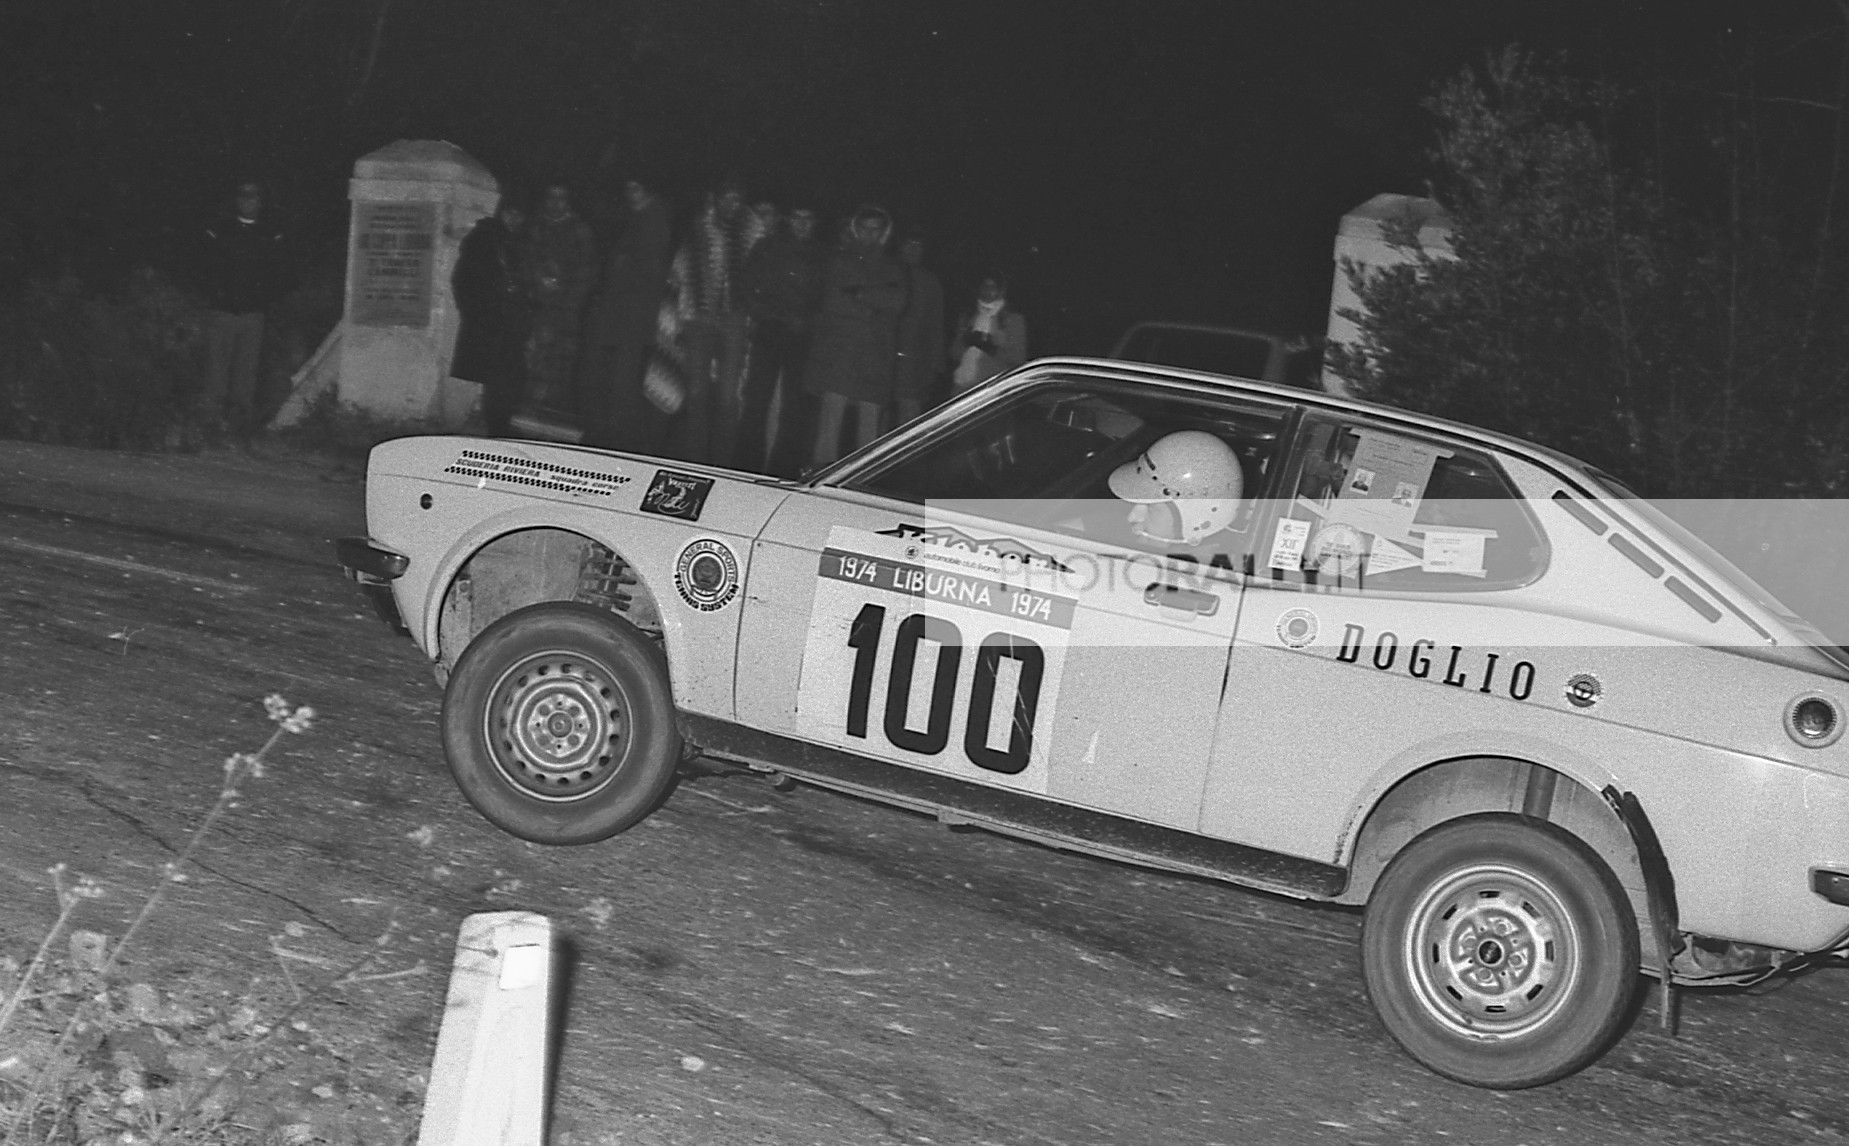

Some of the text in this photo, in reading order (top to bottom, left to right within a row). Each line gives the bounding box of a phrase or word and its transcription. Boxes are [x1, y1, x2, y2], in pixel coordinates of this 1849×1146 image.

[455, 458, 500, 472] SCUDERIA
[503, 466, 540, 478] RIVIERA
[680, 542, 735, 583] GENERAL SPORTS
[838, 556, 1051, 620] 1974 LIBURNA 1974
[847, 603, 1043, 774] 100
[1337, 622, 1536, 702] DOGLIO
